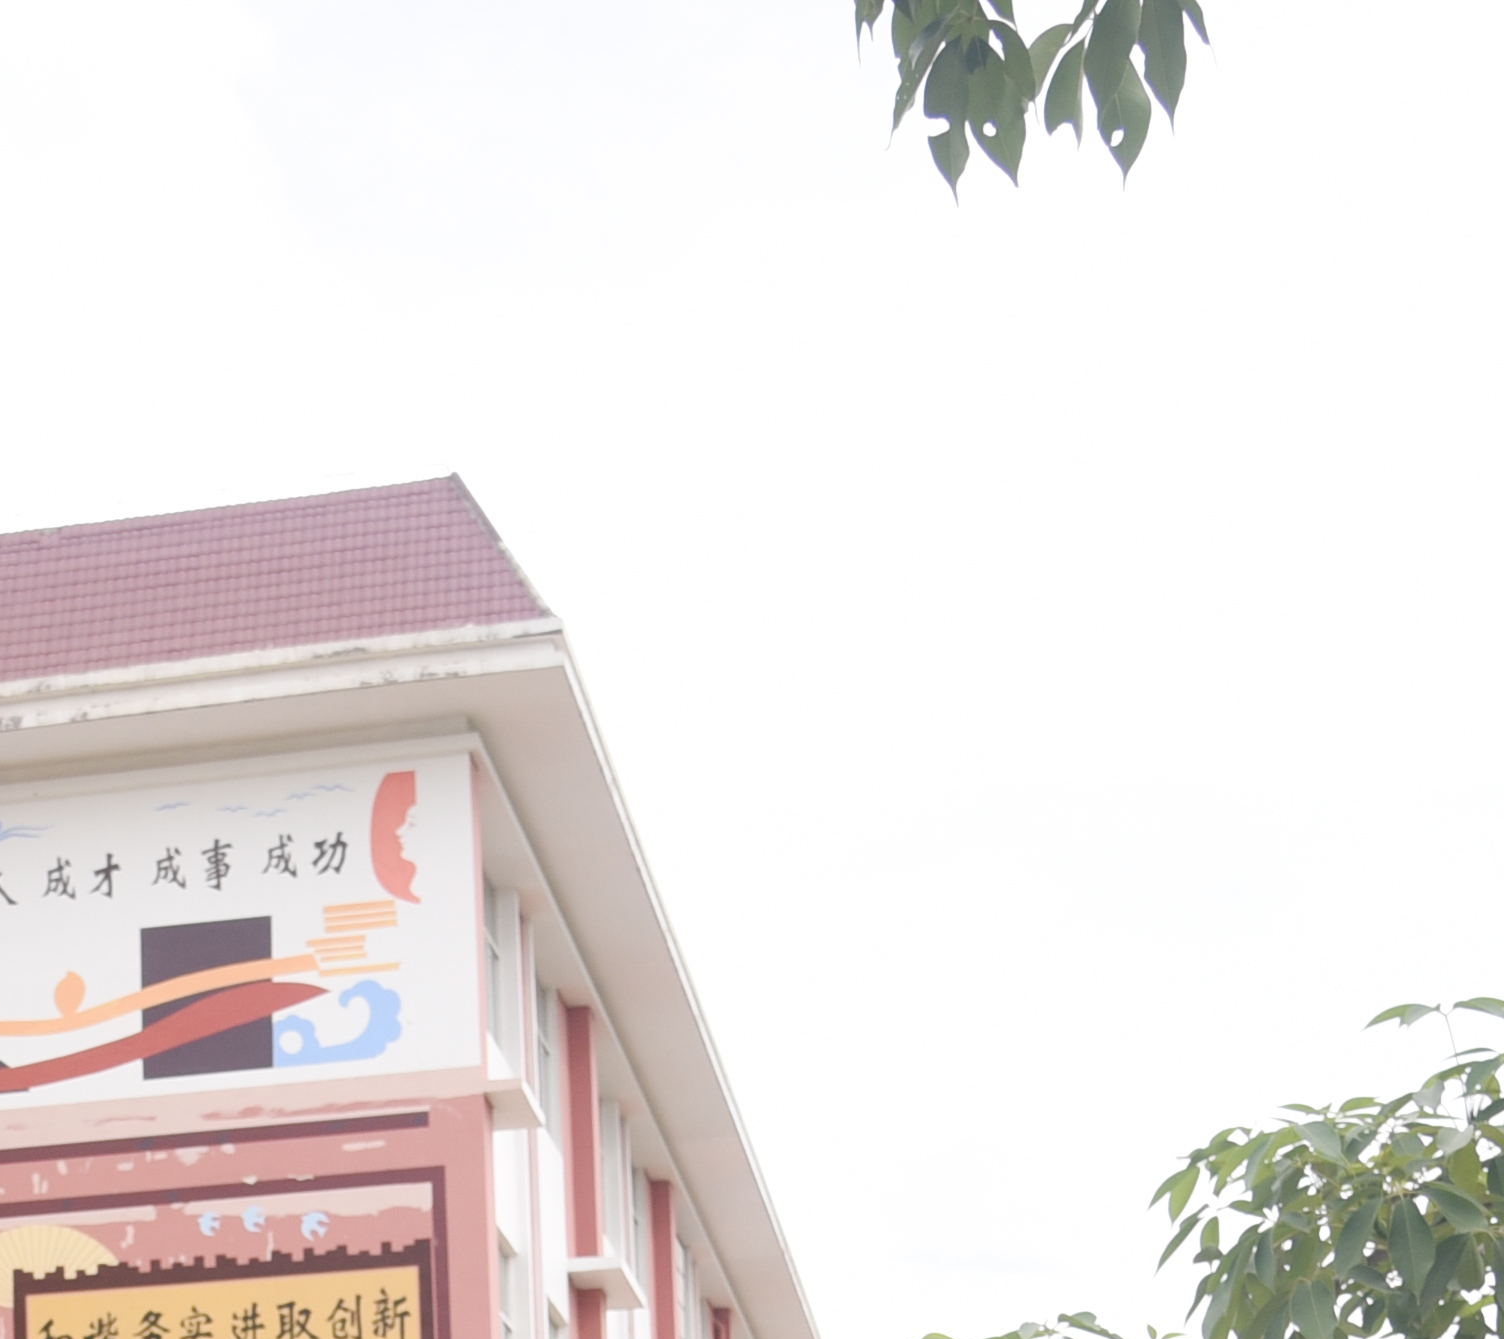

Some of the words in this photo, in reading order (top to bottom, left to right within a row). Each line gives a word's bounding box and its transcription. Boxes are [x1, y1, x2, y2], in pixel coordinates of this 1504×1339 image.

[42, 853, 122, 899] 成才
[152, 837, 233, 891] 成事
[262, 831, 349, 879] 成功
